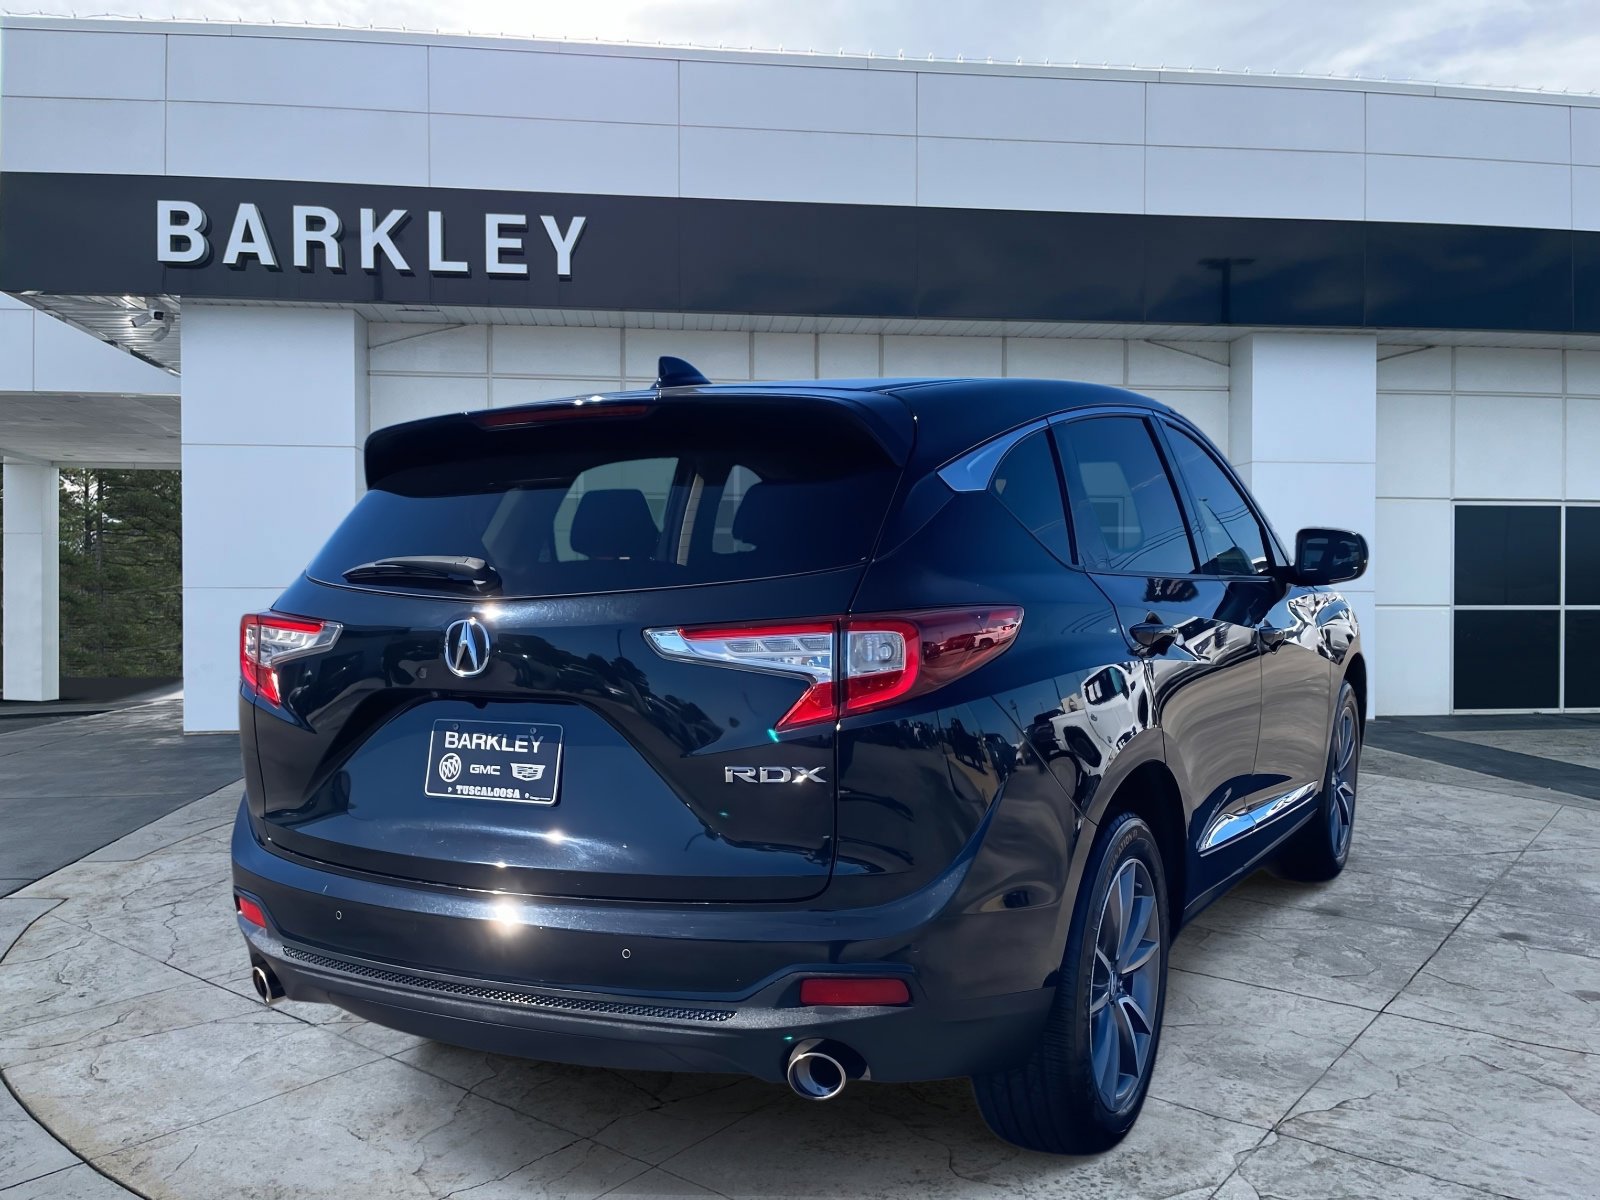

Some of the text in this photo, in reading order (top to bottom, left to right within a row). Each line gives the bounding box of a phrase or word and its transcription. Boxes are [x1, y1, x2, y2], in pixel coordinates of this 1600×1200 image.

[156, 199, 587, 278] BARKLEY
[444, 731, 545, 753] BARKLEY
[469, 763, 501, 775] GMC
[724, 766, 827, 783] RDX
[455, 785, 521, 799] TUSCALOOSA
